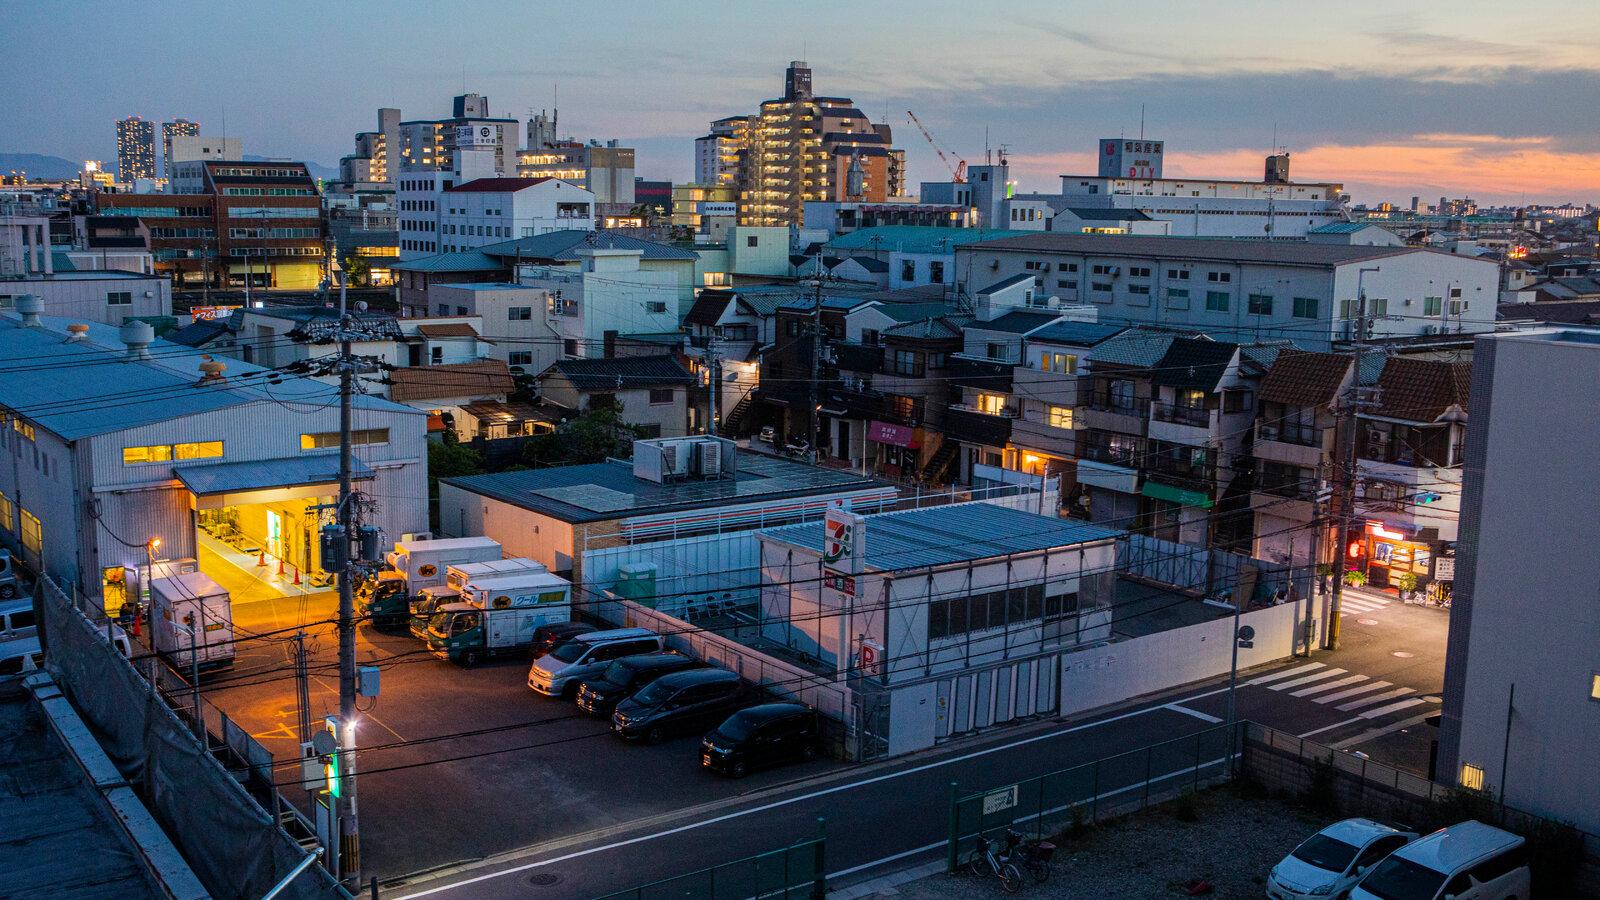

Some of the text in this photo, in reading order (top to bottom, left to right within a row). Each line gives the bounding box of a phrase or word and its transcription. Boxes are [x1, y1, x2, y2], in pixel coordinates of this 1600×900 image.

[1130, 167, 1155, 178] DIY
[516, 595, 538, 605] クール
[864, 646, 874, 669] P
